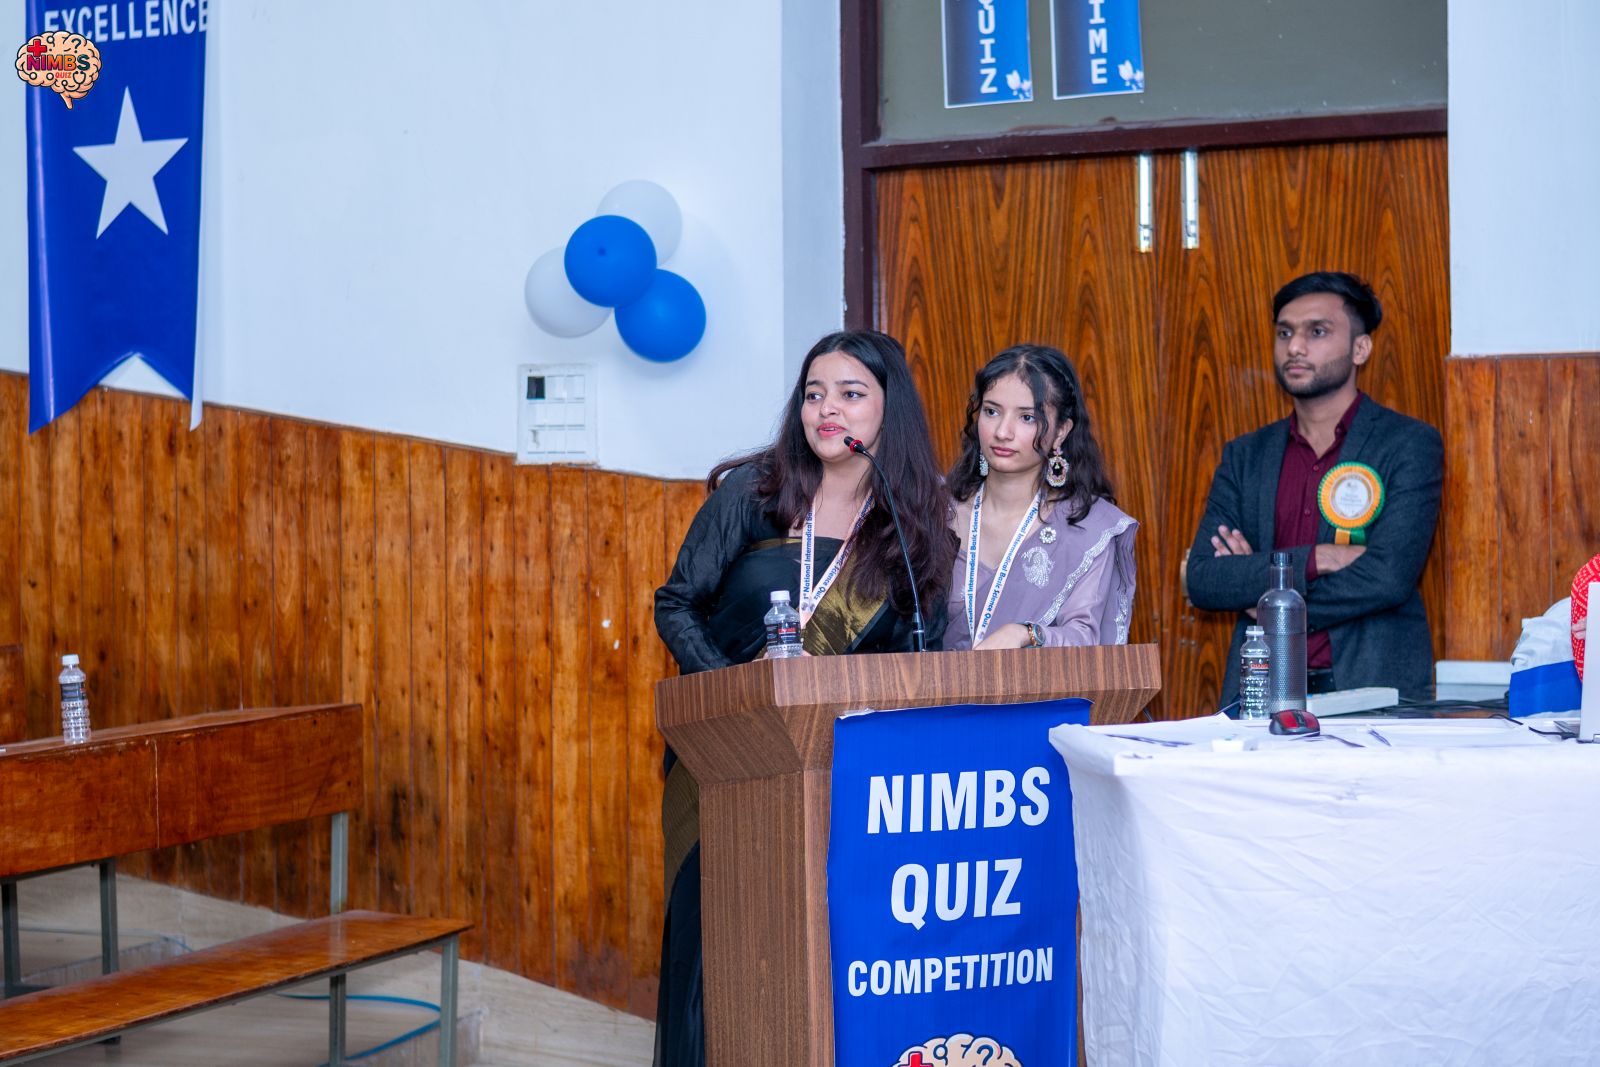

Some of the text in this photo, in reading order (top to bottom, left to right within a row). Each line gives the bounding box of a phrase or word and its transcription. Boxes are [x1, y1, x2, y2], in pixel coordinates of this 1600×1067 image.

[1021, 507, 1038, 534] National
[805, 522, 813, 562] Intermedical
[803, 564, 811, 593] National
[824, 565, 840, 588] Science
[814, 586, 826, 600] Quiz
[987, 589, 1000, 612] Science
[982, 612, 991, 628] Quiz
[867, 766, 1050, 834] NIMBS
[891, 858, 1022, 930] QUIZ
[848, 947, 1053, 996] COMPETITION
